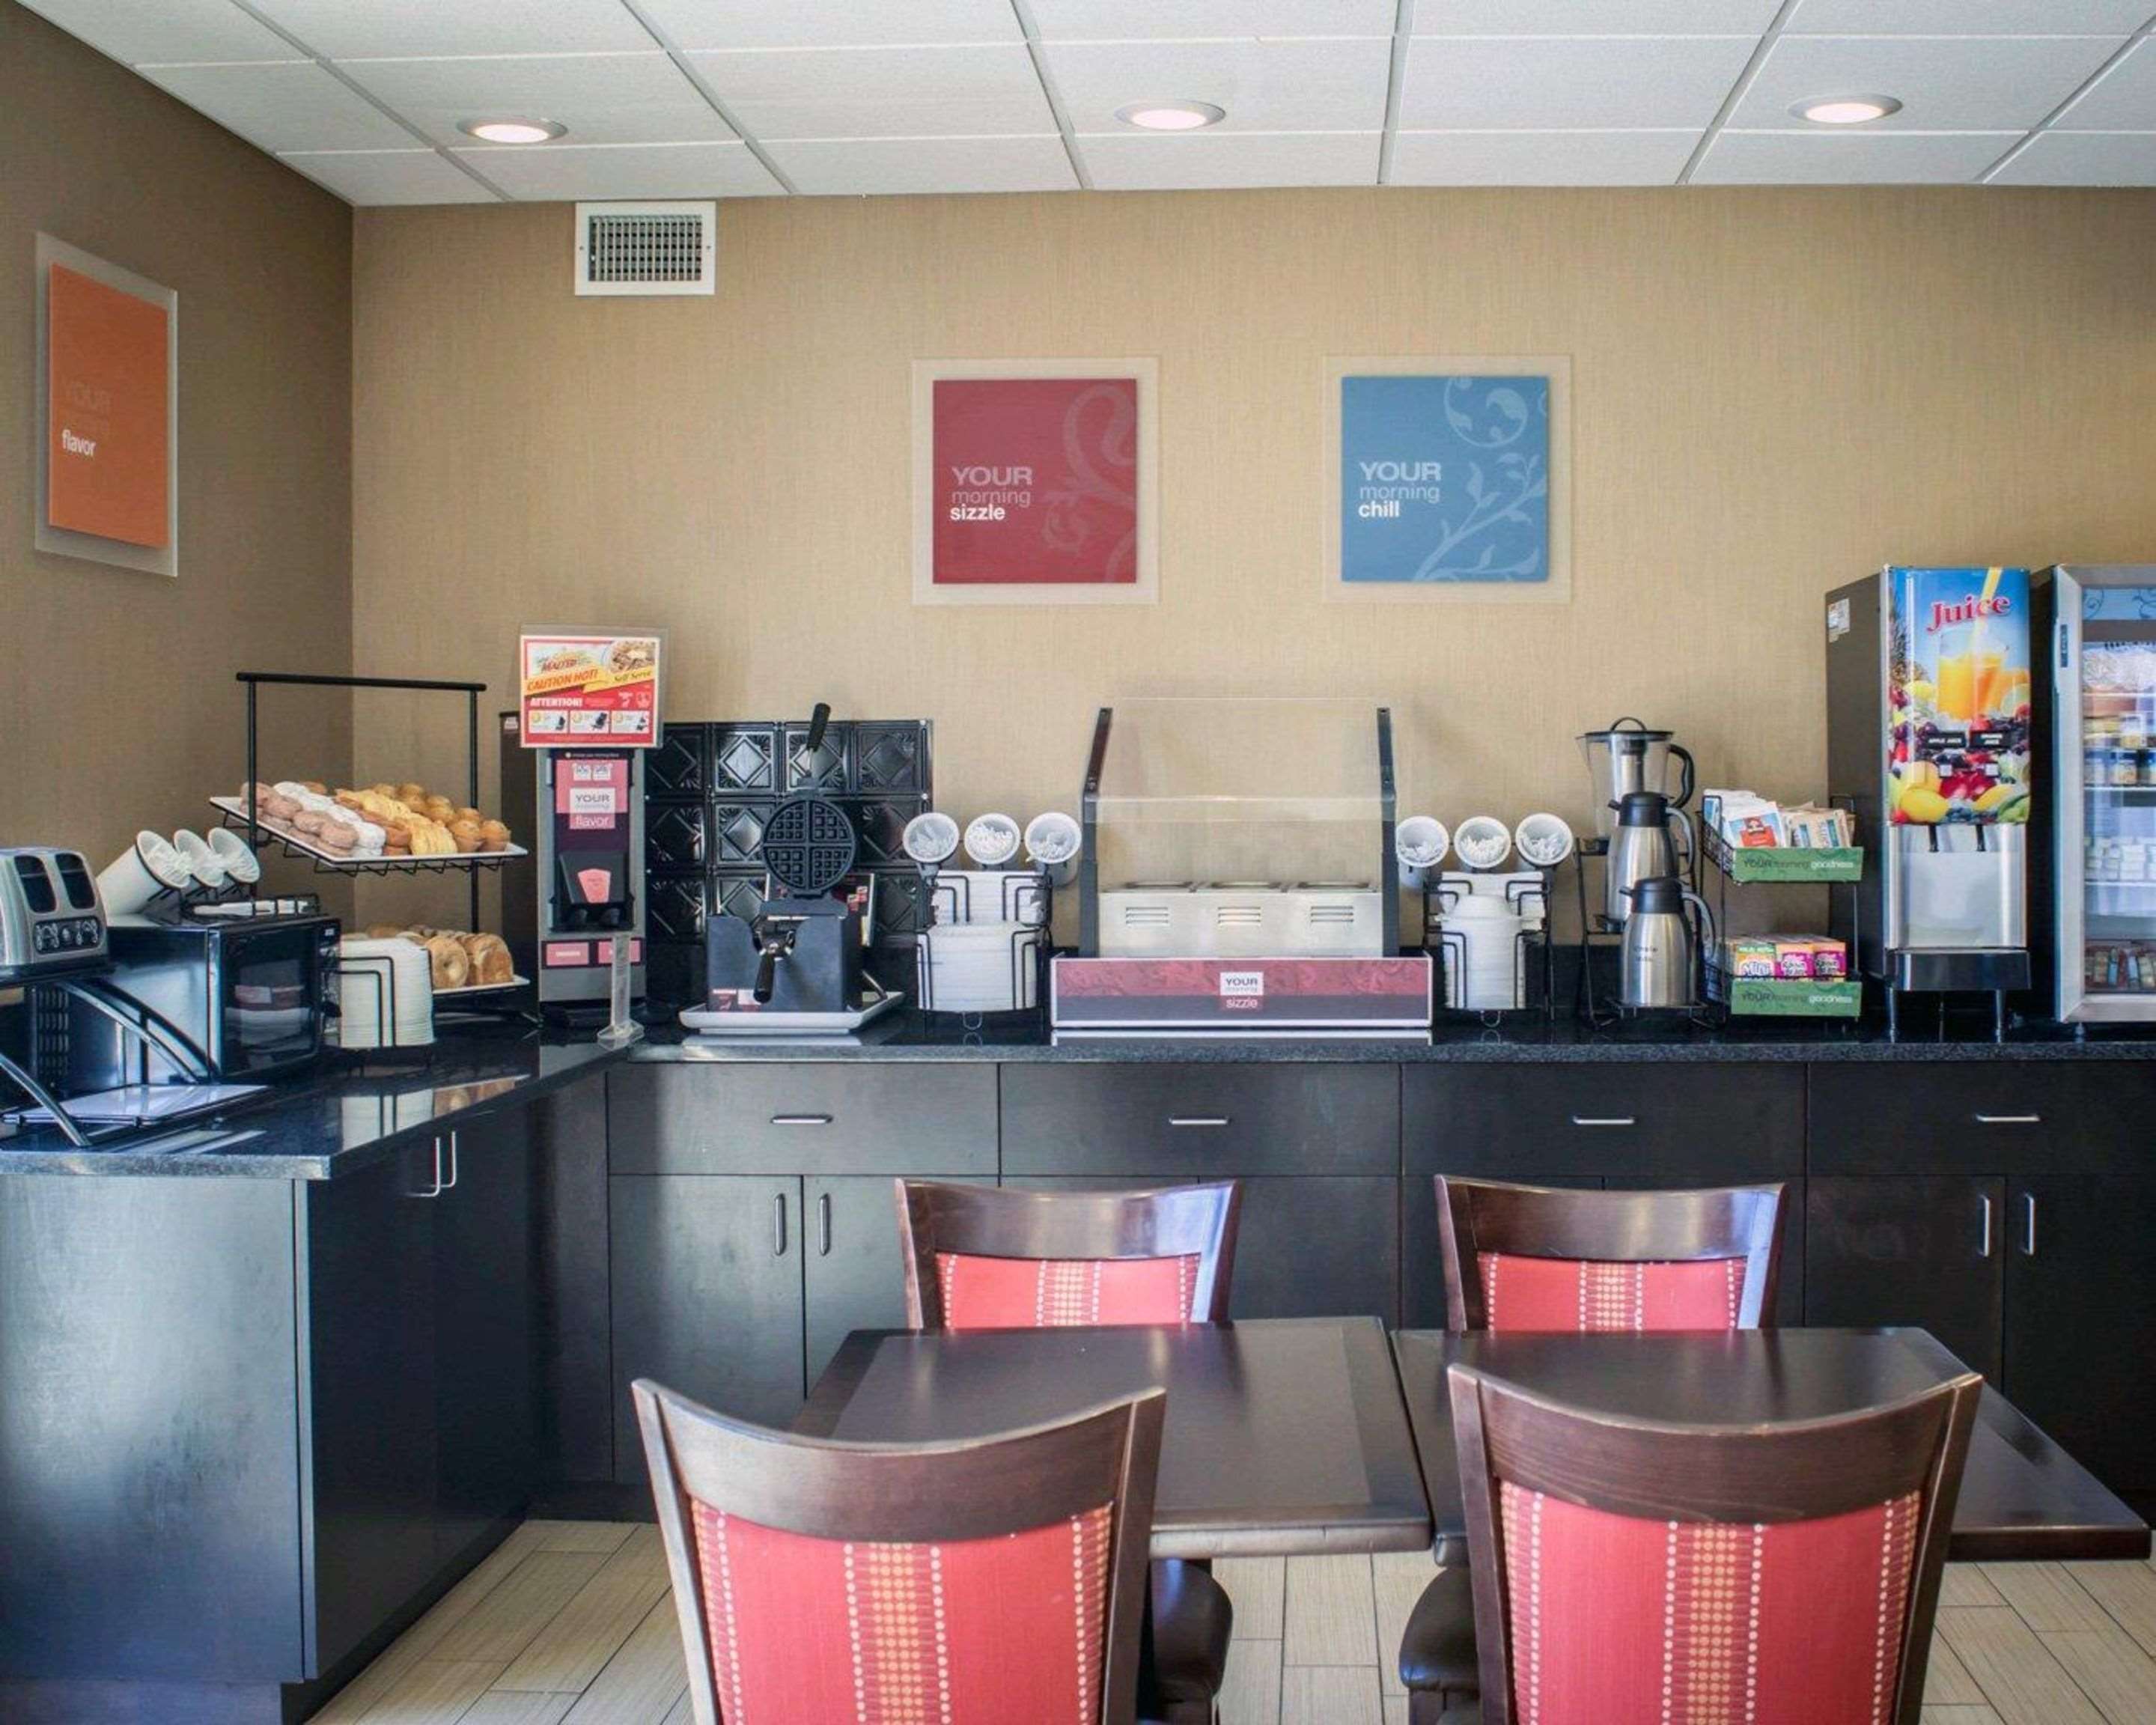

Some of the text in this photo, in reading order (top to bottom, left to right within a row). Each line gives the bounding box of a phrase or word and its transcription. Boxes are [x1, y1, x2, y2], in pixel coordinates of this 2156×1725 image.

[62, 429, 96, 457] flavor
[951, 466, 1032, 485] YOUR
[1359, 462, 1442, 481] YOUR
[952, 487, 1031, 508] morning
[1360, 483, 1440, 503] morning
[950, 503, 1005, 520] sizzle
[1358, 500, 1400, 517] chill
[1927, 594, 2011, 632] Juice
[527, 674, 571, 690] CAUTION
[576, 794, 610, 803] YOUR
[576, 815, 609, 827] flavor
[1226, 977, 1258, 986] YOUR
[1226, 997, 1258, 1008] sizzle
